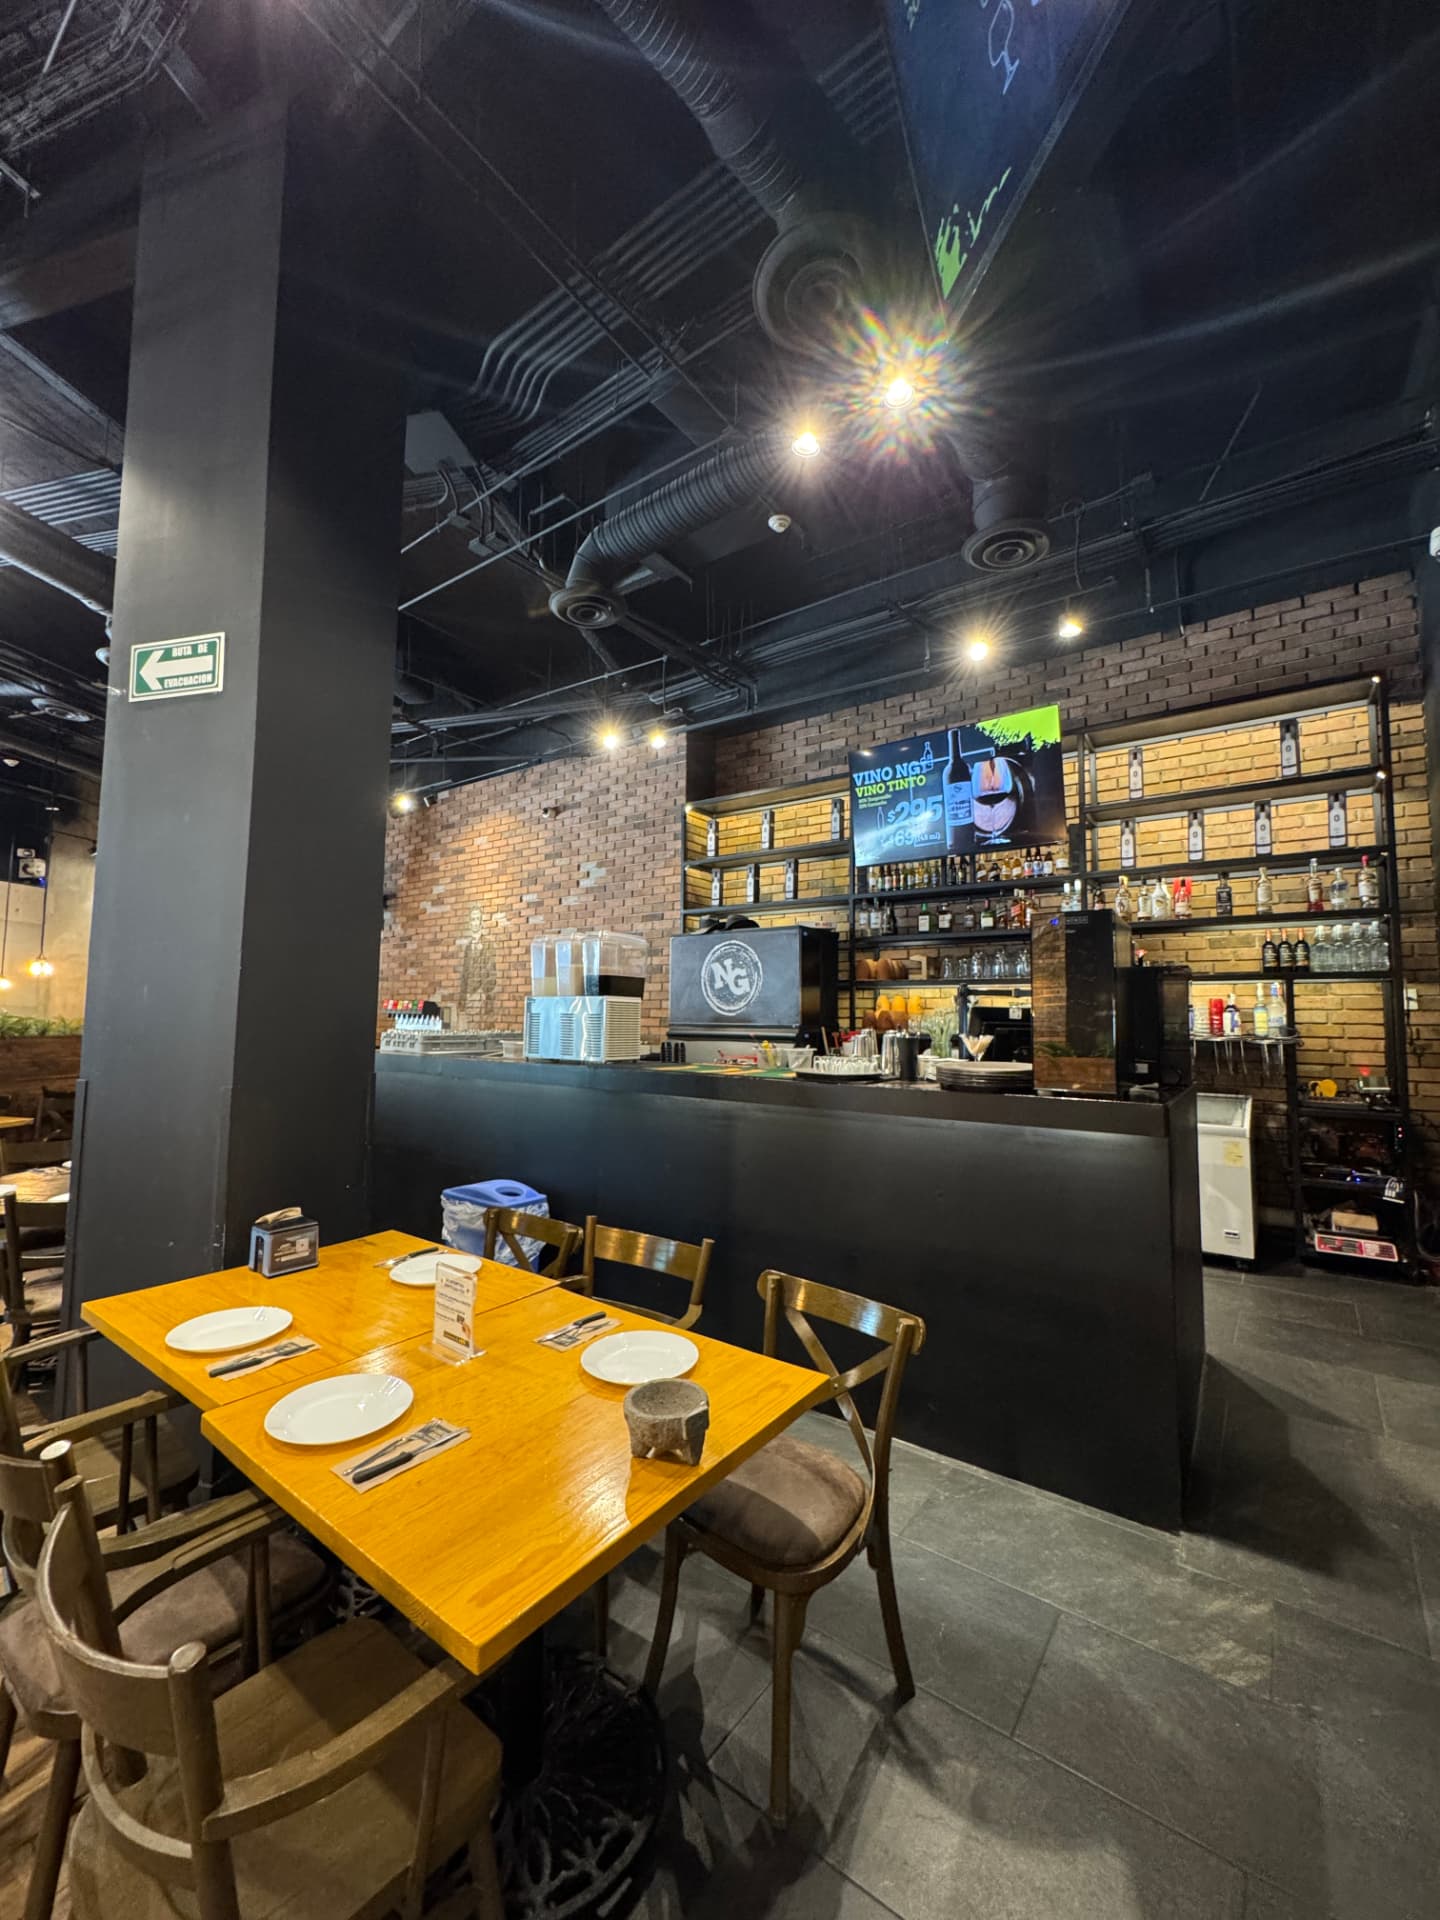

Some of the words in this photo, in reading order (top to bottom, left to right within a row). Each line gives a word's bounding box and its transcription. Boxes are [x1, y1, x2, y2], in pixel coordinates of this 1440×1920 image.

[172, 645, 192, 657] RUTA
[197, 643, 208, 654] DE
[853, 767, 892, 786] VINO
[855, 783, 886, 798] VINO
[886, 774, 927, 792] TINTO
[710, 958, 750, 996] NG
